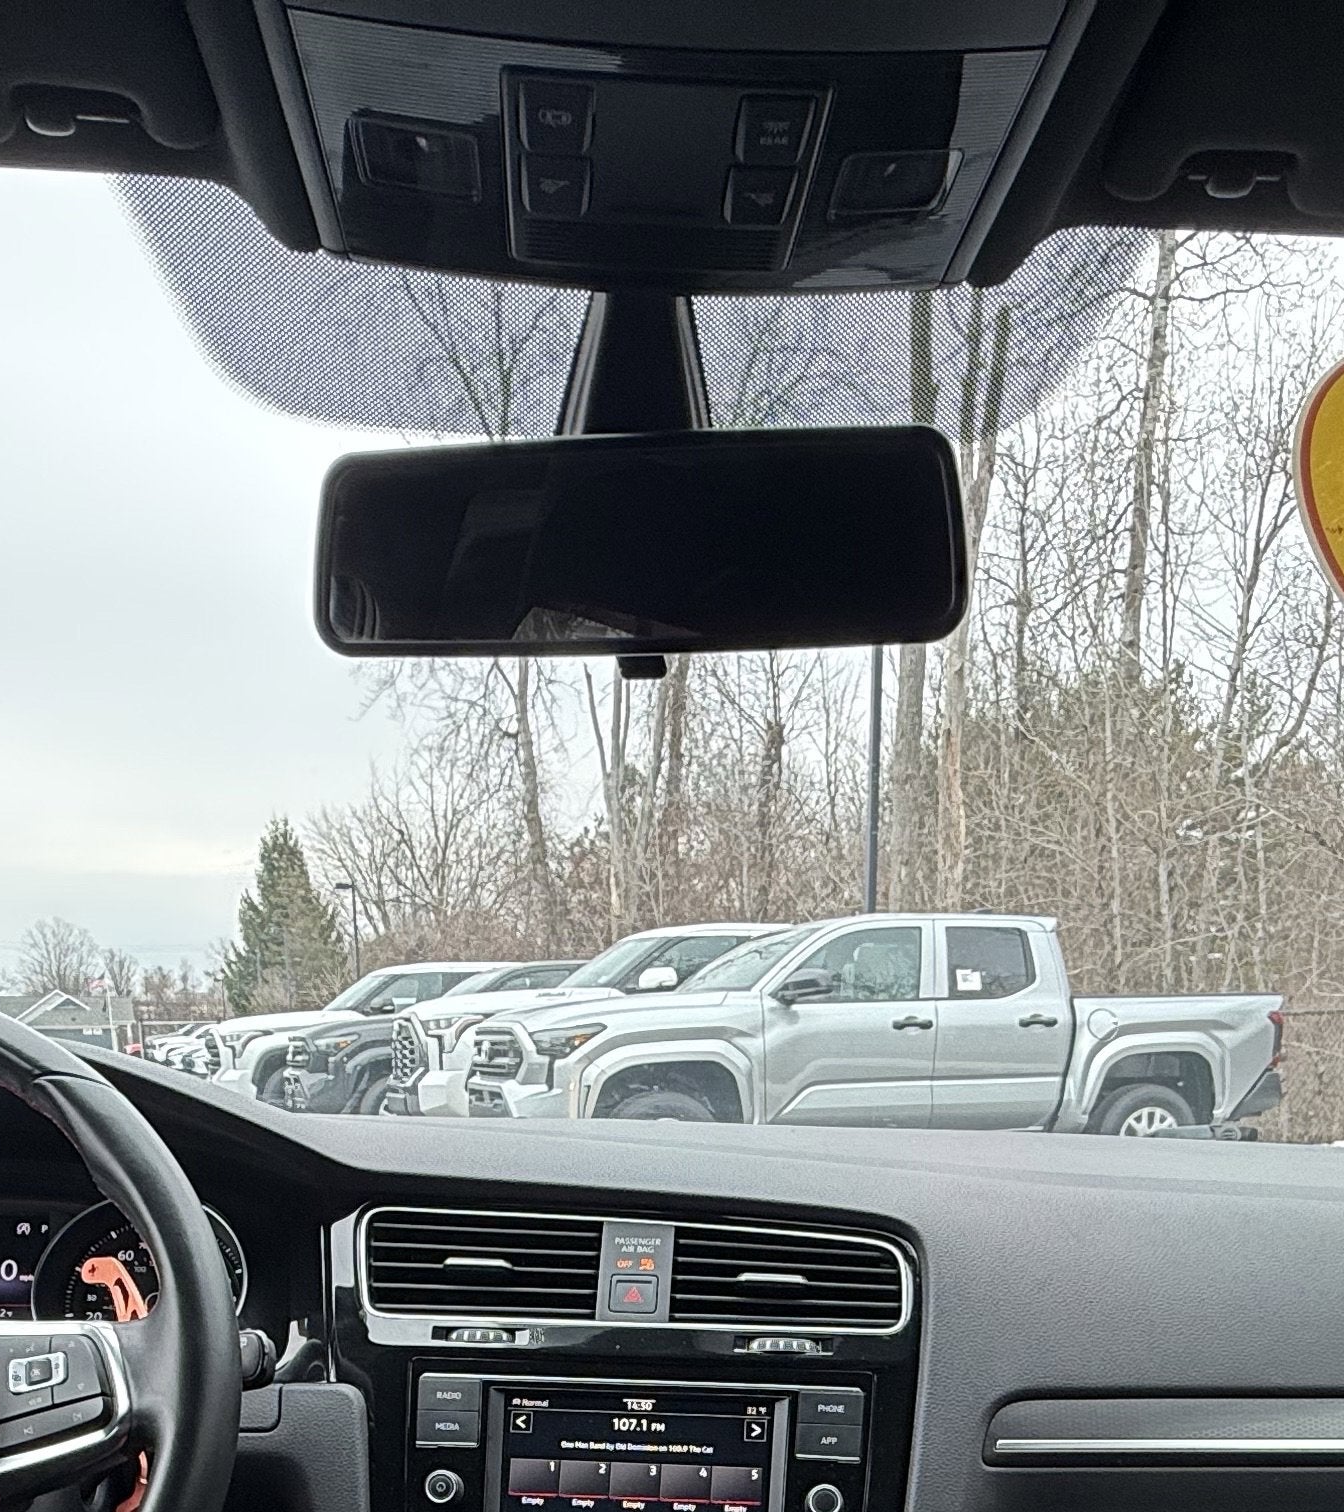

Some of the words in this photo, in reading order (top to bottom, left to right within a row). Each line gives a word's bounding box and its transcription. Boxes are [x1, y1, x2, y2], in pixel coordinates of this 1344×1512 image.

[40, 1224, 48, 1234] P
[614, 1237, 662, 1246] PASSENGER
[117, 1250, 134, 1261] 60
[616, 1260, 633, 1268] OFF
[0, 1259, 18, 1282] 0
[436, 1392, 462, 1400] RADIO
[626, 1400, 652, 1411] 14:50
[818, 1404, 845, 1413] PHONE
[436, 1422, 460, 1430] MEDIA
[612, 1418, 648, 1432] 107.1
[651, 1422, 666, 1432] FM
[820, 1436, 838, 1445] APP
[549, 1461, 555, 1472] 1
[599, 1464, 607, 1474] 2
[649, 1465, 656, 1476] 3
[699, 1467, 708, 1478] 4
[752, 1470, 758, 1480] 5
[521, 1496, 544, 1506] Empty
[572, 1498, 594, 1508] Empty
[622, 1500, 646, 1510] Empty
[673, 1502, 696, 1512] Empty
